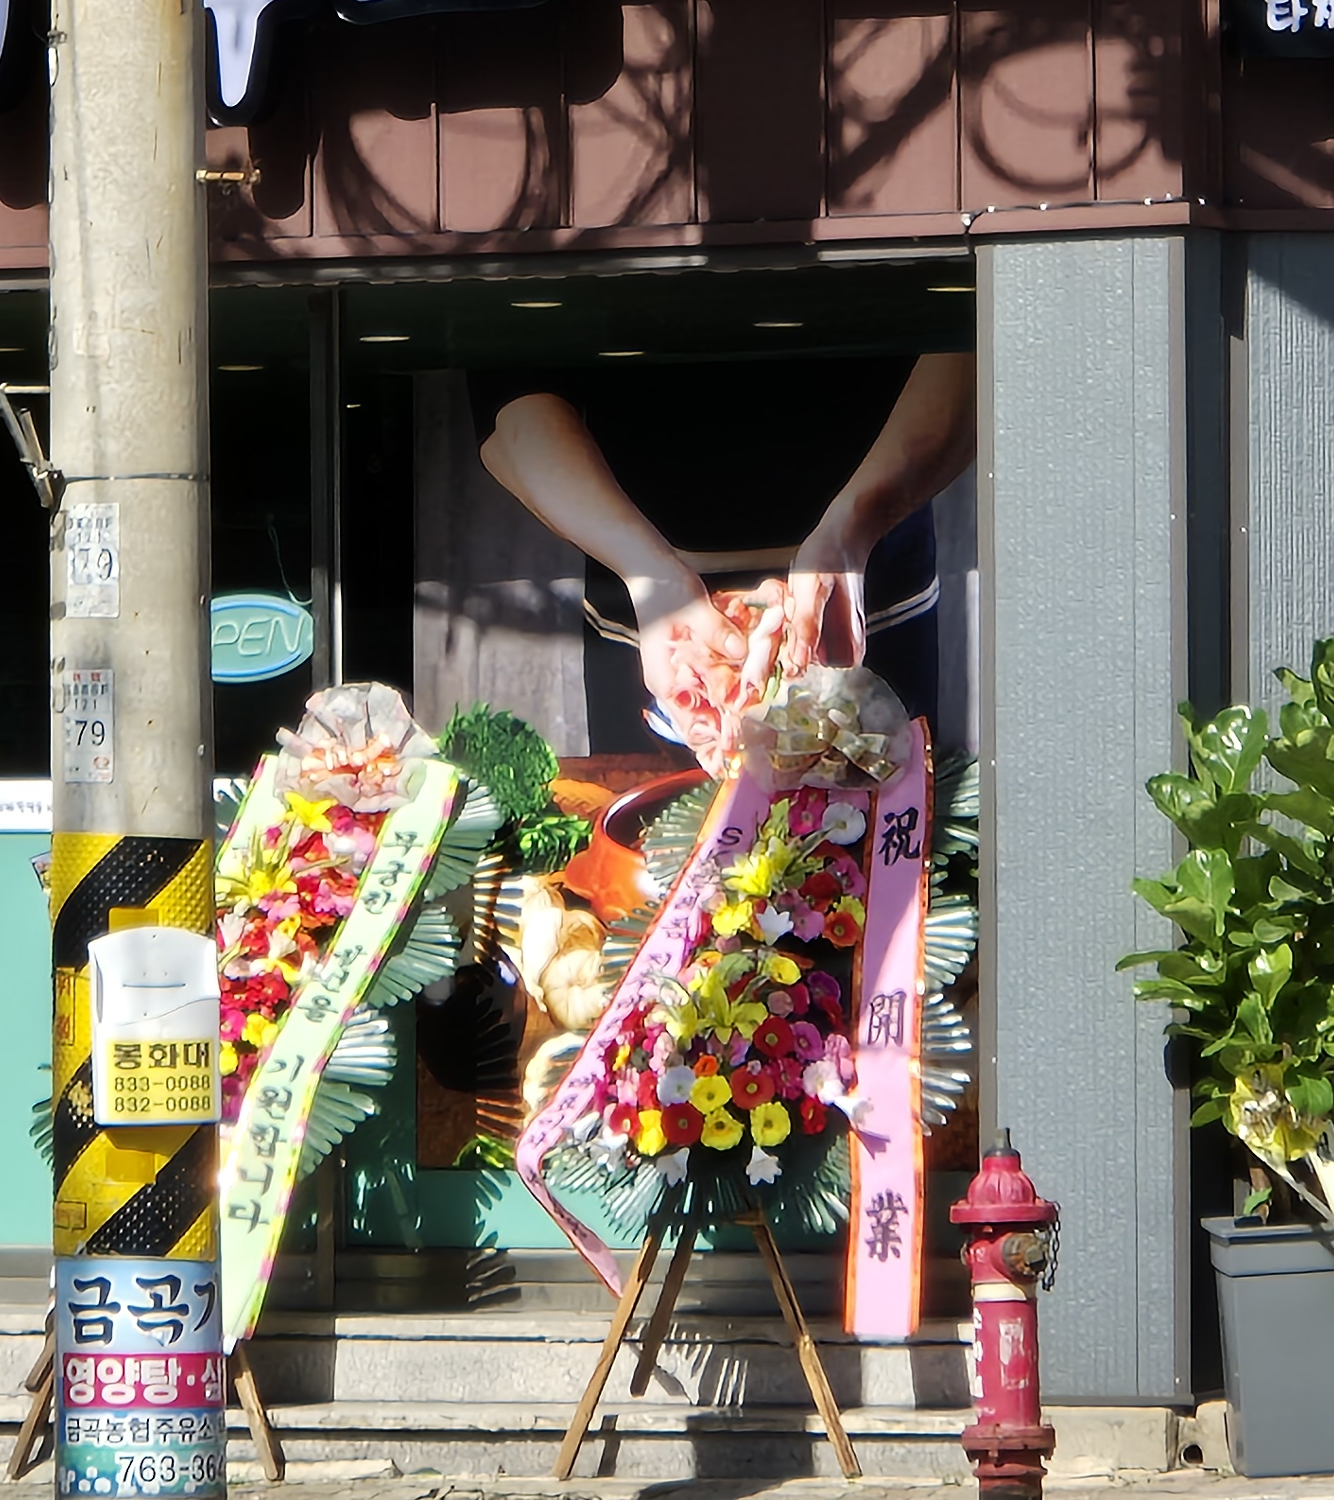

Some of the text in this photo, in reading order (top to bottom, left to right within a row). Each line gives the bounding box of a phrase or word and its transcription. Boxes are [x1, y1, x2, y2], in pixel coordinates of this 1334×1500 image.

[212, 613, 306, 657] PEN
[74, 719, 107, 747] 79
[114, 1074, 211, 1093] 833-0088
[114, 1095, 212, 1113] 832-0088
[227, 1053, 306, 1236] 기원합니다
